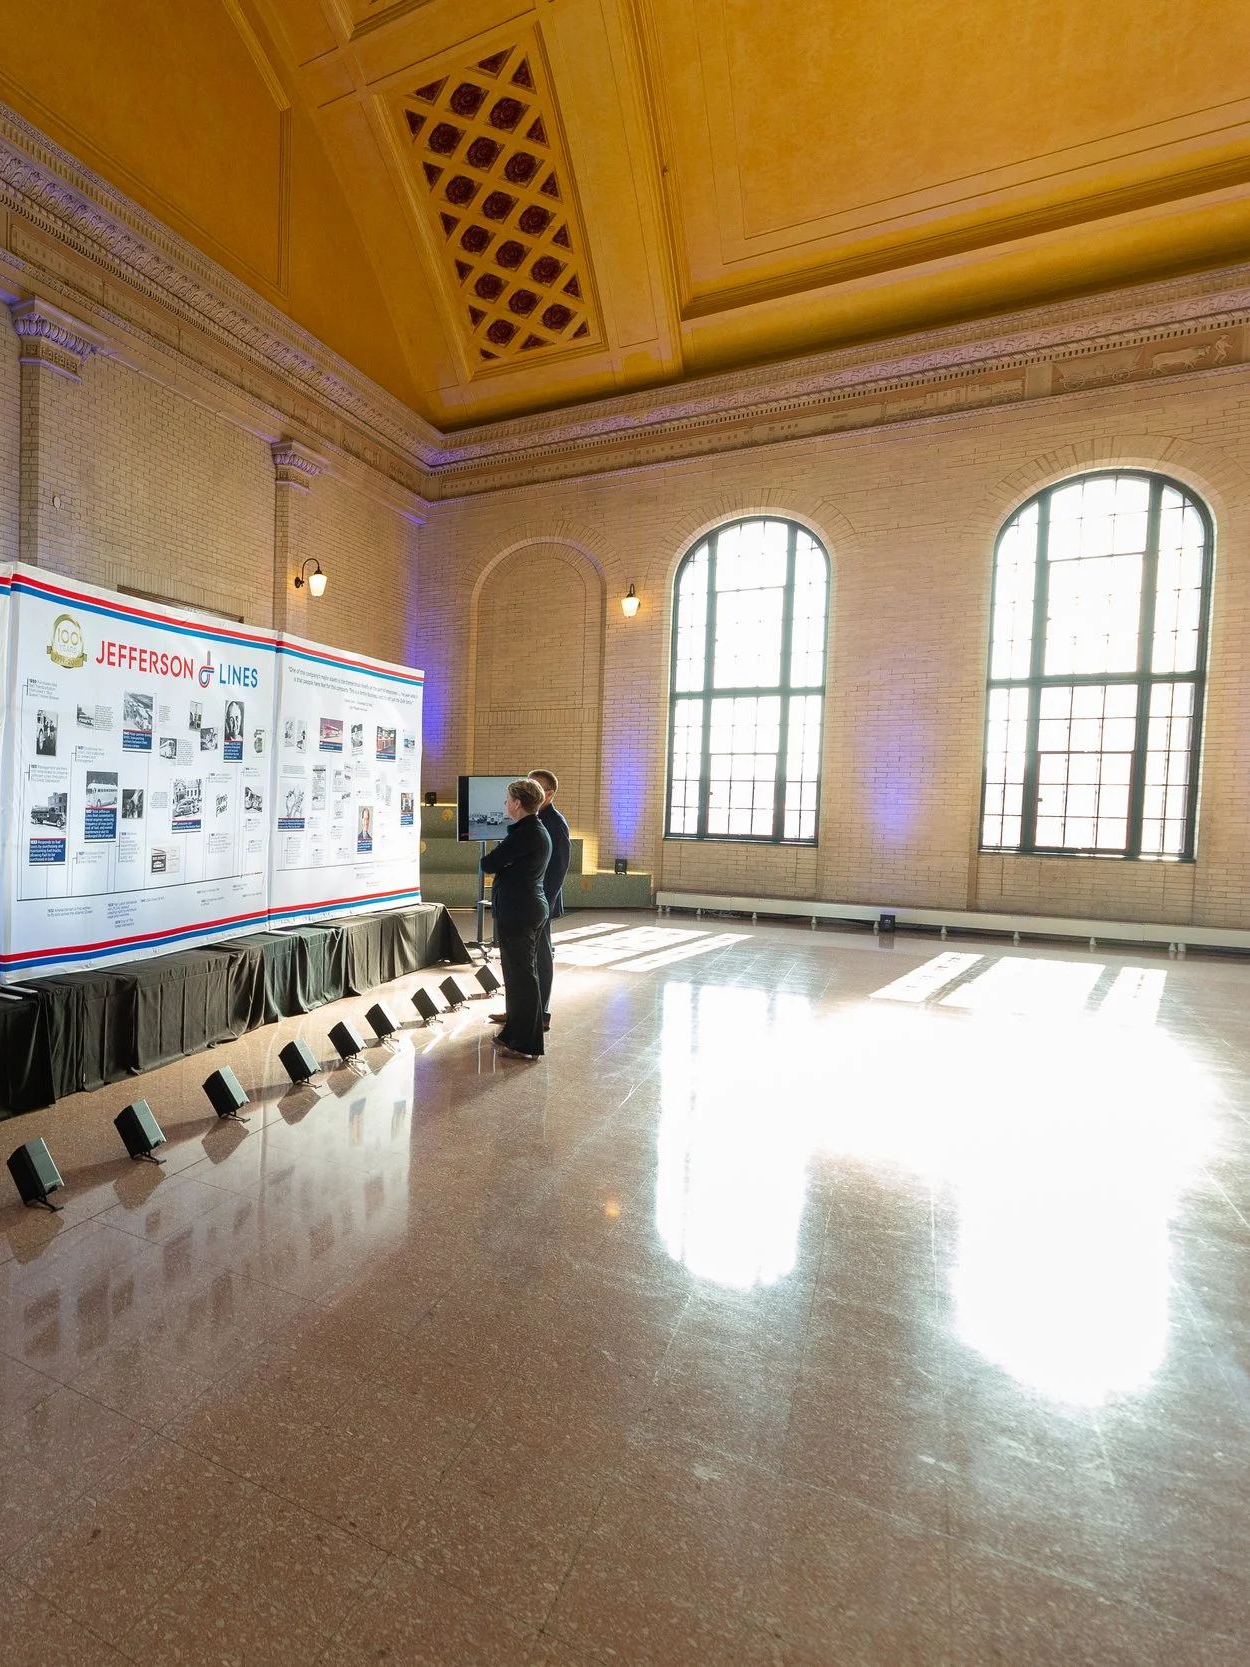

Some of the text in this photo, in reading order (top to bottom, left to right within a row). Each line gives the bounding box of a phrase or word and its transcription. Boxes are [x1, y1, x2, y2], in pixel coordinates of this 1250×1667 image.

[58, 628, 78, 646] 100
[96, 640, 258, 688] JEFFERSON LINES
